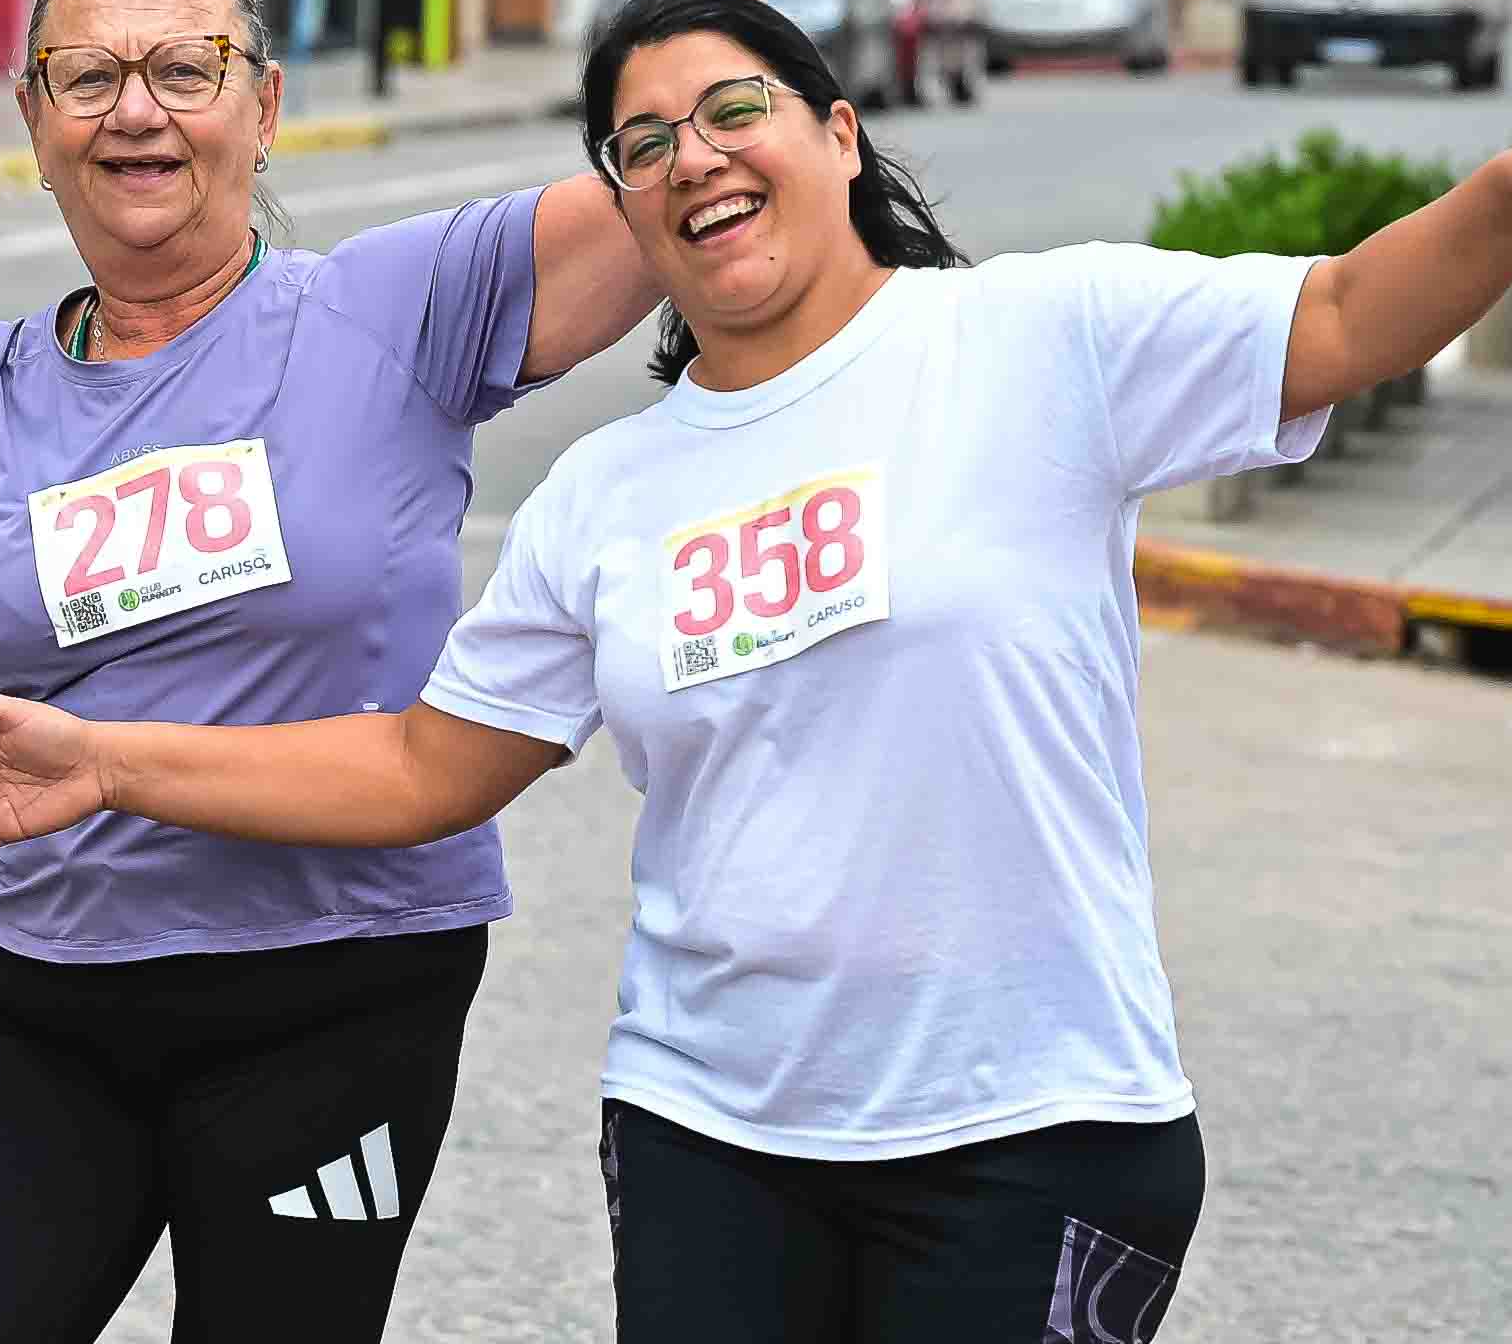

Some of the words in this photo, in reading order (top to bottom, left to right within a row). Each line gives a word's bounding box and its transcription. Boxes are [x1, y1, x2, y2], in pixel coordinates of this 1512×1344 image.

[55, 461, 252, 598] 278
[198, 557, 267, 585] CARUSO
[674, 487, 865, 636] 358
[139, 582, 162, 596] CLUB
[807, 595, 865, 628] CARUSO
